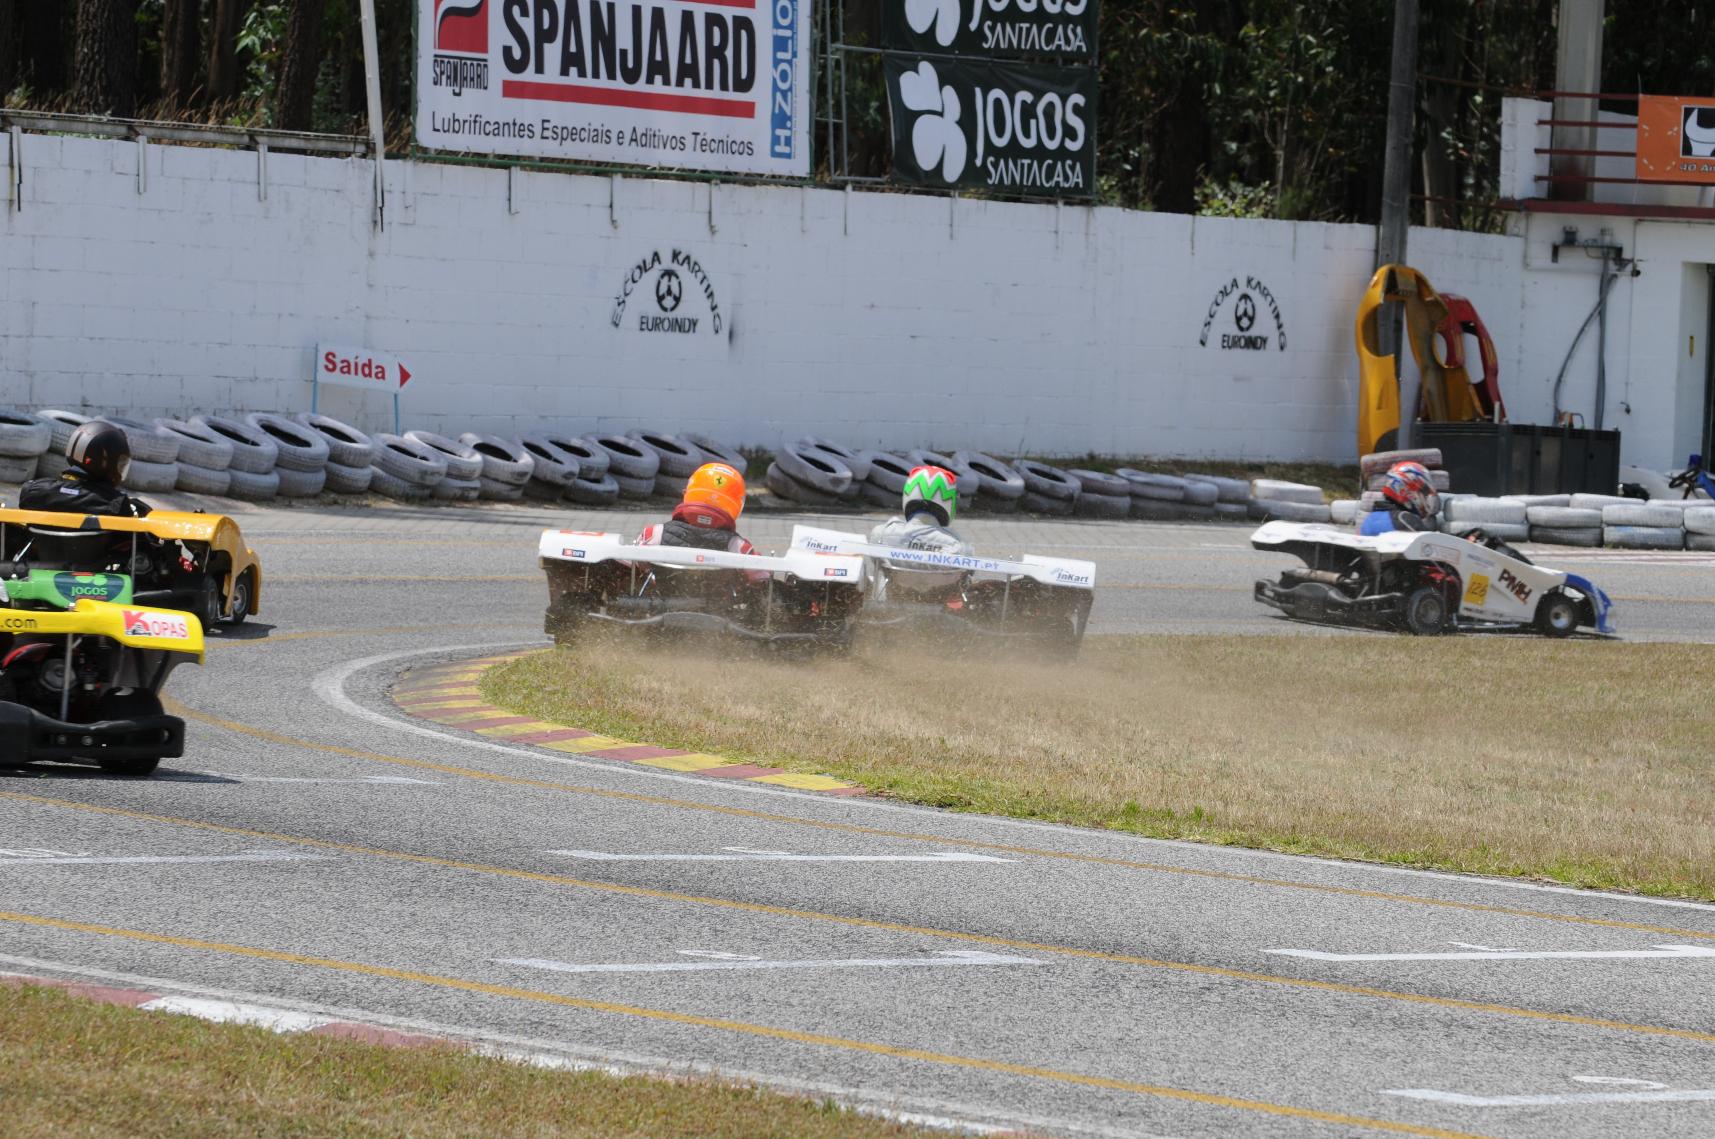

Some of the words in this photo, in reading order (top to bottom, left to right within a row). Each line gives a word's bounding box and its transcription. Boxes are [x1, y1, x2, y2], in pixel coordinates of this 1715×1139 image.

[502, 0, 757, 93] SPANJAARD
[433, 55, 489, 96] SPANJAARD
[432, 111, 535, 139] Lubrificantes
[541, 119, 612, 146] Especiais
[617, 130, 625, 146] e
[628, 126, 687, 152] Aditivos
[692, 132, 755, 157] Técnicos
[975, 86, 1086, 168] JOGOS
[611, 250, 662, 329] ESCOLA
[671, 248, 722, 335] KARTING
[639, 315, 699, 334] EUROINDY
[1221, 334, 1268, 351] EUROINDY
[324, 351, 386, 381] Saída
[71, 586, 108, 597] JOGOS
